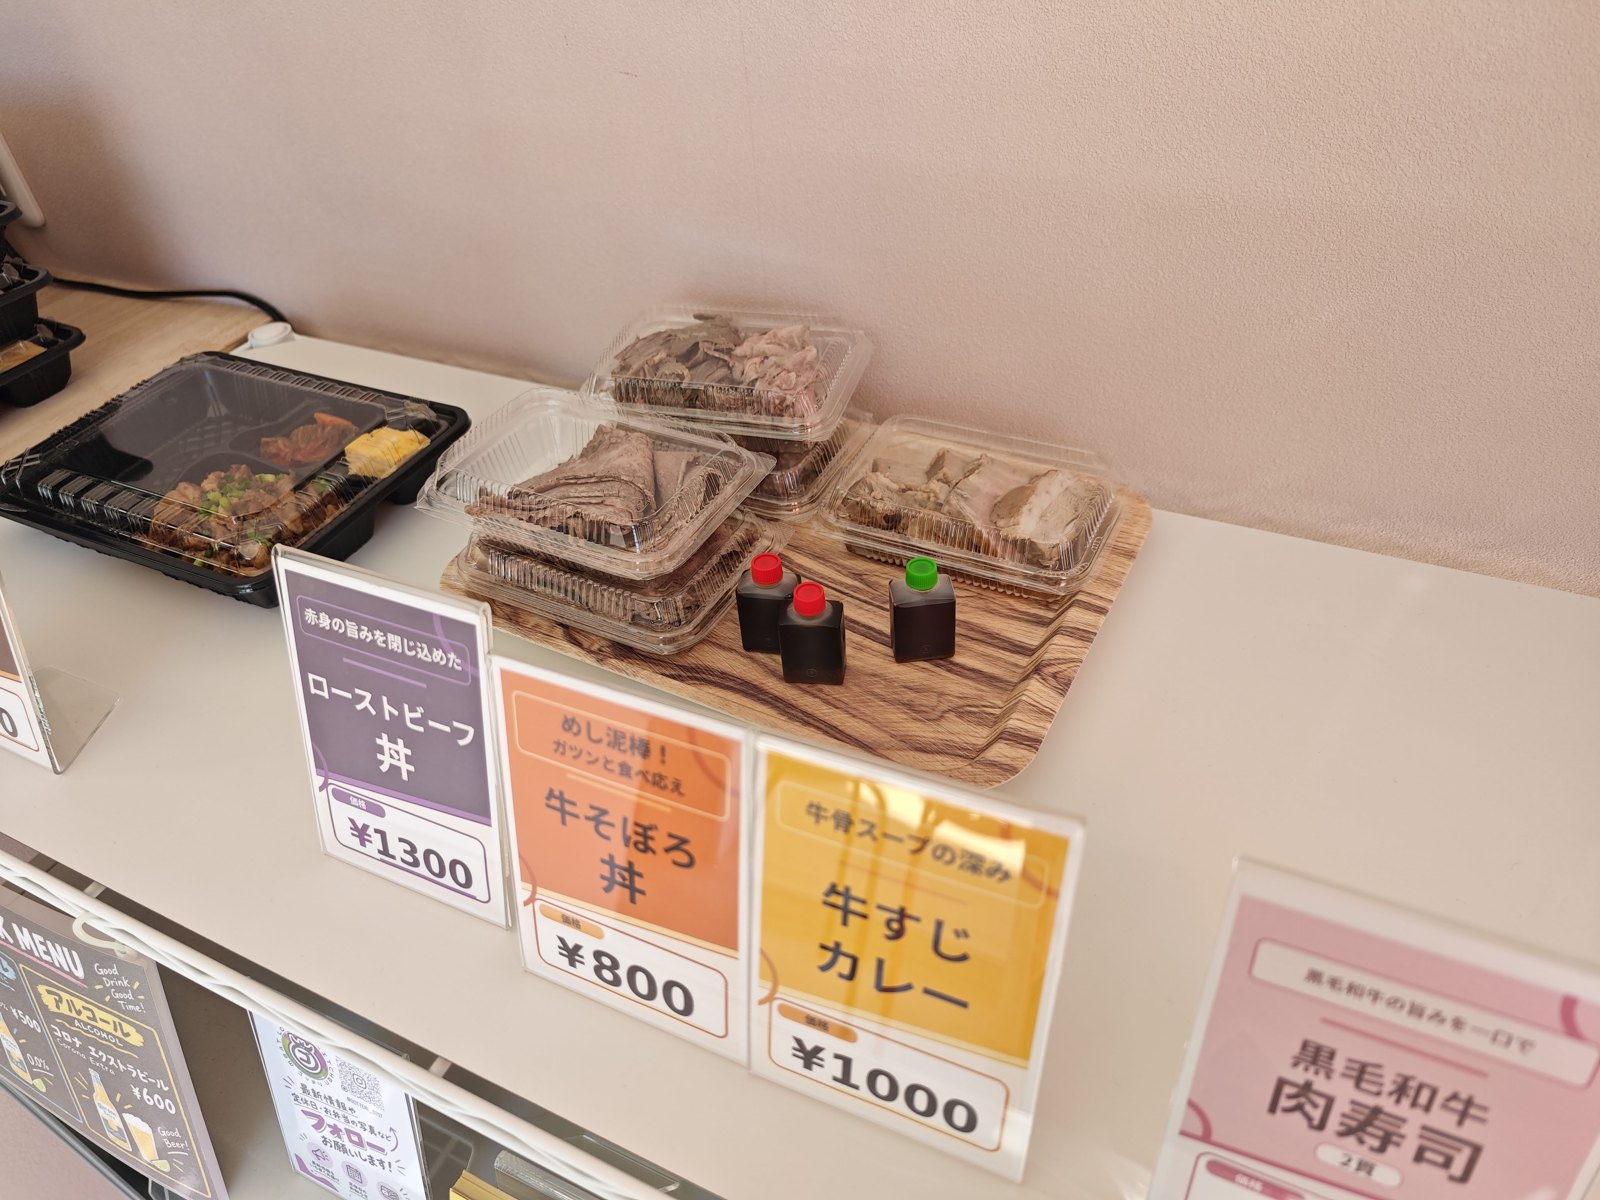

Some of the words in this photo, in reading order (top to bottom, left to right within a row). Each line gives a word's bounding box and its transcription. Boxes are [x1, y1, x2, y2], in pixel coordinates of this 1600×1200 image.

[304, 607, 463, 671] 赤身の旨みを閉じ込めた
[307, 671, 475, 746] ローストビーフ
[375, 732, 415, 781] 丼
[553, 739, 686, 797] ガツンと食べ応え
[348, 816, 473, 890] ¥1300
[544, 787, 696, 869] 牛そぼろ
[805, 801, 1013, 883] 牛骨スープの深み
[600, 853, 646, 905] 丼
[11, 922, 85, 980] MENU
[821, 881, 971, 964] 牛すじ
[94, 963, 119, 976] Good
[102, 976, 131, 988] Drink
[111, 989, 134, 1001] Good
[556, 934, 694, 1017] ¥800
[817, 940, 969, 1010] カレー
[45, 988, 131, 1038] アルコール
[50, 1024, 82, 1048] コロナ
[74, 1019, 124, 1047] ALCOHOL
[1303, 968, 1536, 1056] 黒毛和牛の旨みを一口で
[57, 1038, 87, 1060] Corona
[89, 1056, 116, 1075] Extra
[791, 1036, 978, 1134] ¥1000
[1291, 1038, 1491, 1129] 黒毛和牛
[130, 1083, 176, 1115] ¥600
[300, 1083, 357, 1115] 最新情報や
[158, 1126, 182, 1138] Good
[300, 1109, 387, 1155] フォロー
[1266, 1075, 1485, 1185] 肉寿司
